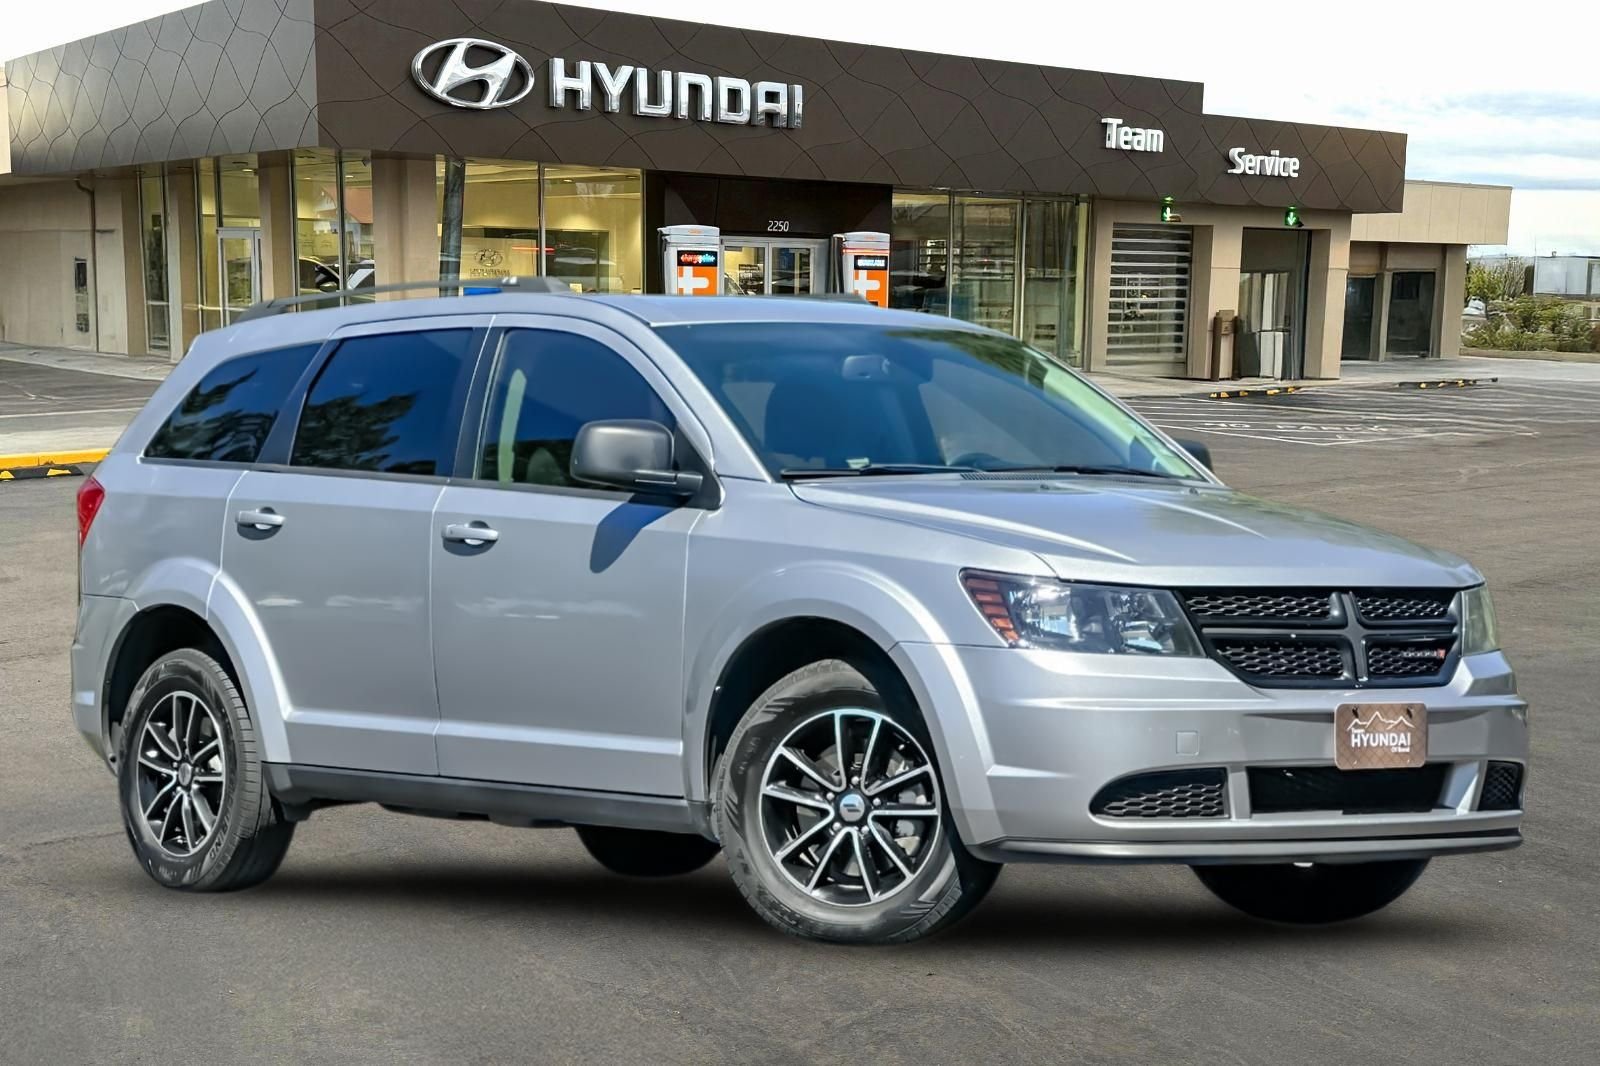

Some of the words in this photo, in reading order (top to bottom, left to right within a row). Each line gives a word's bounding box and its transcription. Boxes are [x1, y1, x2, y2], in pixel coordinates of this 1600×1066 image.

[549, 57, 803, 129] HYUNDAI
[1101, 118, 1164, 152] Team
[1227, 147, 1300, 178] Service
[767, 220, 790, 232] 2250
[1351, 732, 1411, 747] HYUNDAI
